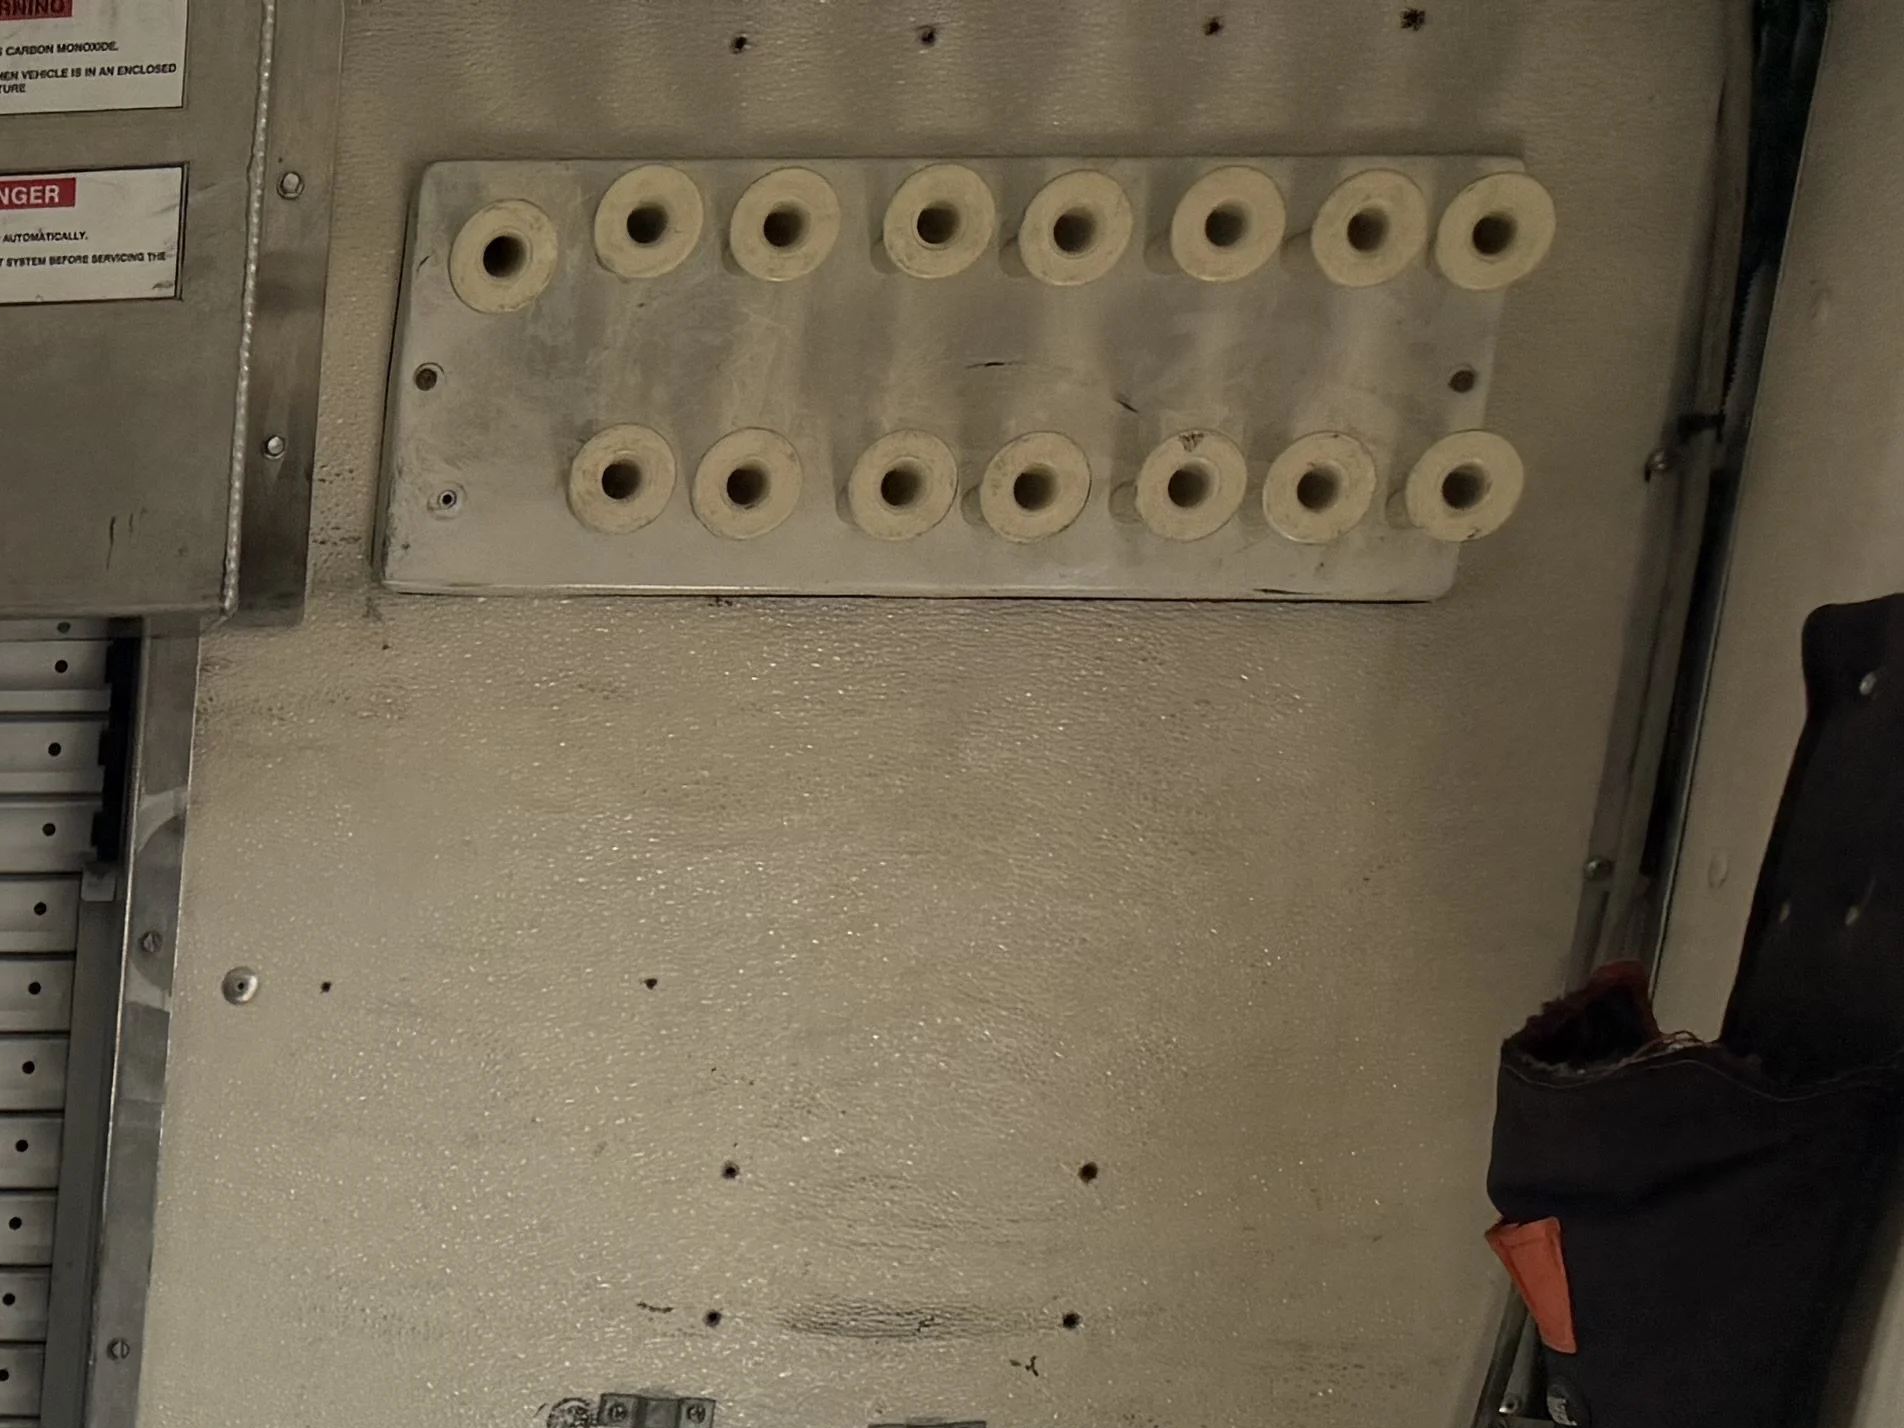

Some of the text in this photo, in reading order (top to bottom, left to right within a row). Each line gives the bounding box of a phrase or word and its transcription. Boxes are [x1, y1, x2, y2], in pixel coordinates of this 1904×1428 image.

[5, 44, 53, 56] CARBON
[22, 68, 67, 81] VEHICLE
[71, 68, 81, 79] IS
[84, 67, 95, 78] IN
[99, 66, 114, 77] AN
[117, 63, 176, 77] ENCLOSED
[6, 256, 45, 268] SYSTEM
[49, 254, 88, 266] BEFORE
[92, 252, 144, 265] SERVICING
[148, 252, 165, 263] THE
